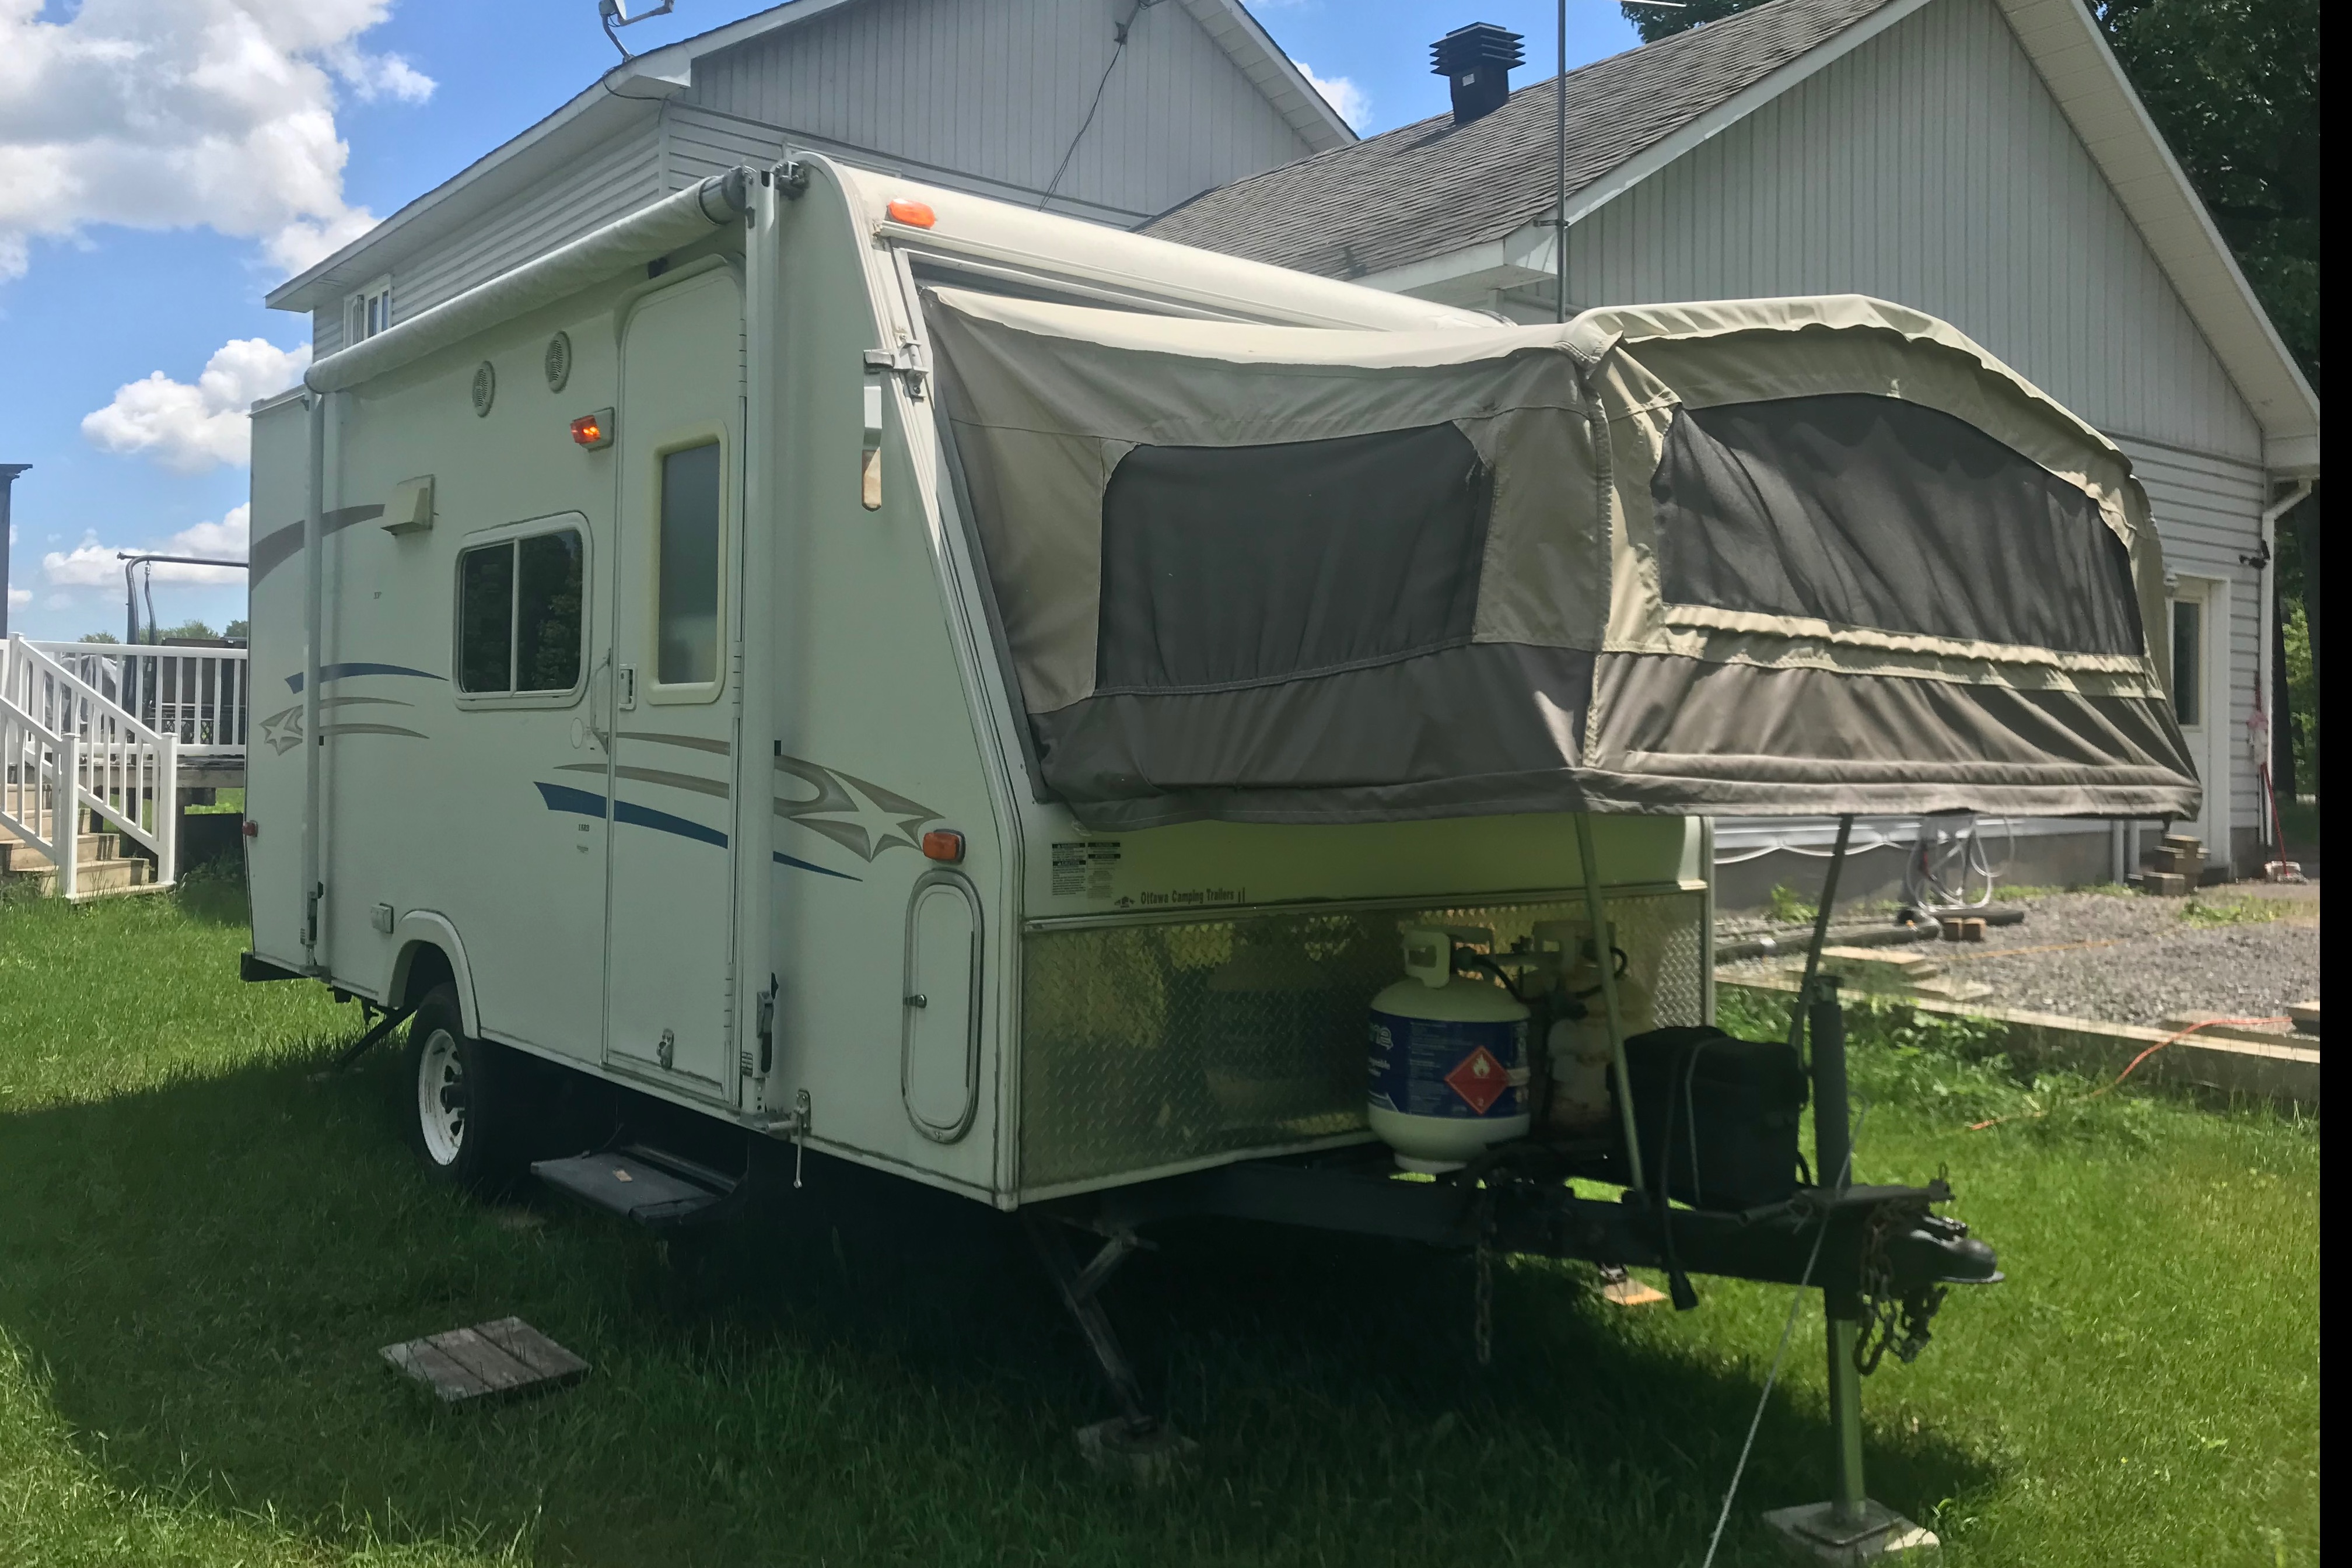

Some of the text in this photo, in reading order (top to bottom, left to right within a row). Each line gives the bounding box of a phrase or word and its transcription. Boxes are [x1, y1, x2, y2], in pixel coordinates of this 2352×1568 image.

[1141, 887, 1234, 905] Ottawa Camping Trailers
